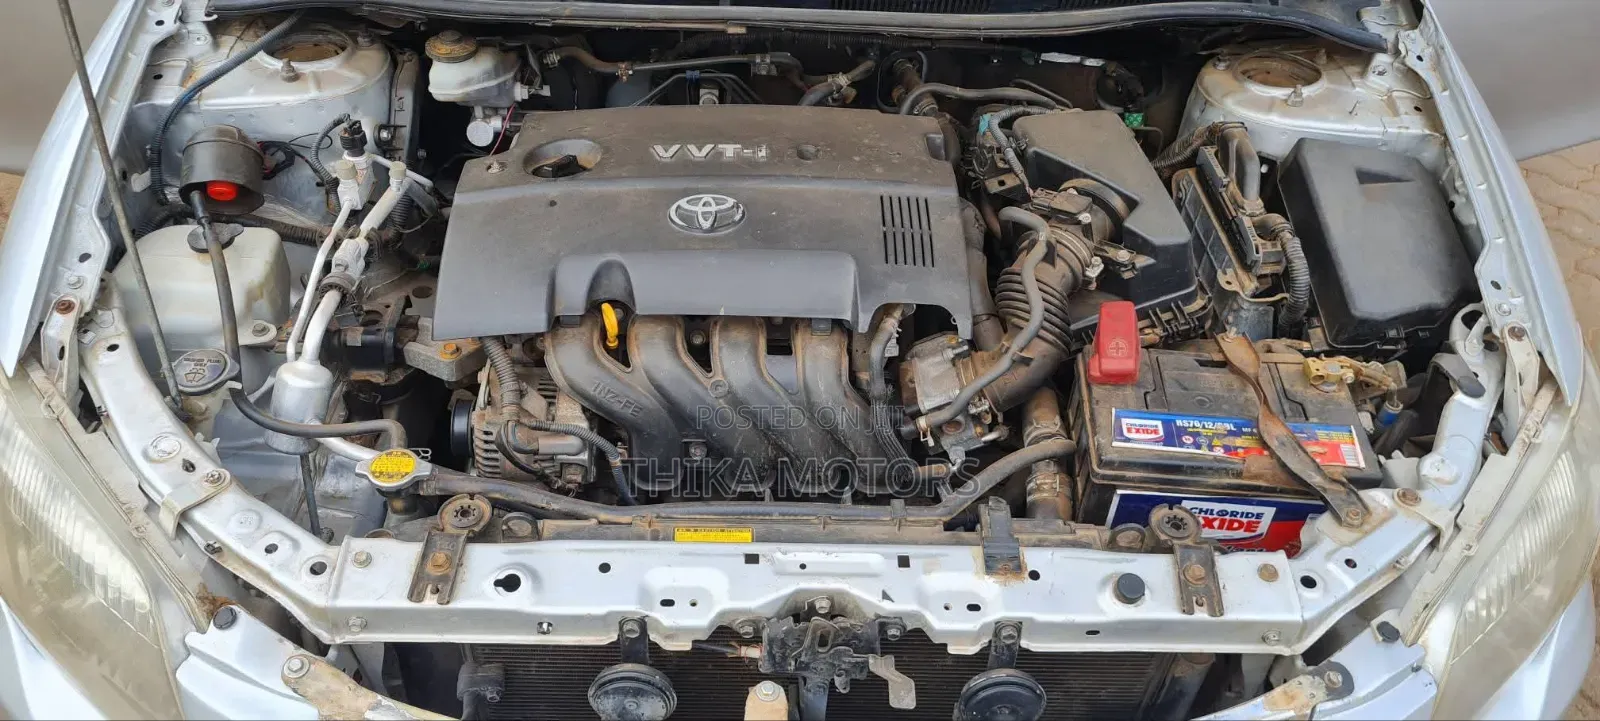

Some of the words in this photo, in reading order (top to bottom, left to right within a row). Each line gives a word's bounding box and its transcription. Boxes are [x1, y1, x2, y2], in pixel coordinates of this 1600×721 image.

[1126, 427, 1160, 436] EXIDE
[1190, 507, 1265, 520] CHLORIDE
[1200, 516, 1262, 533] XIDE
